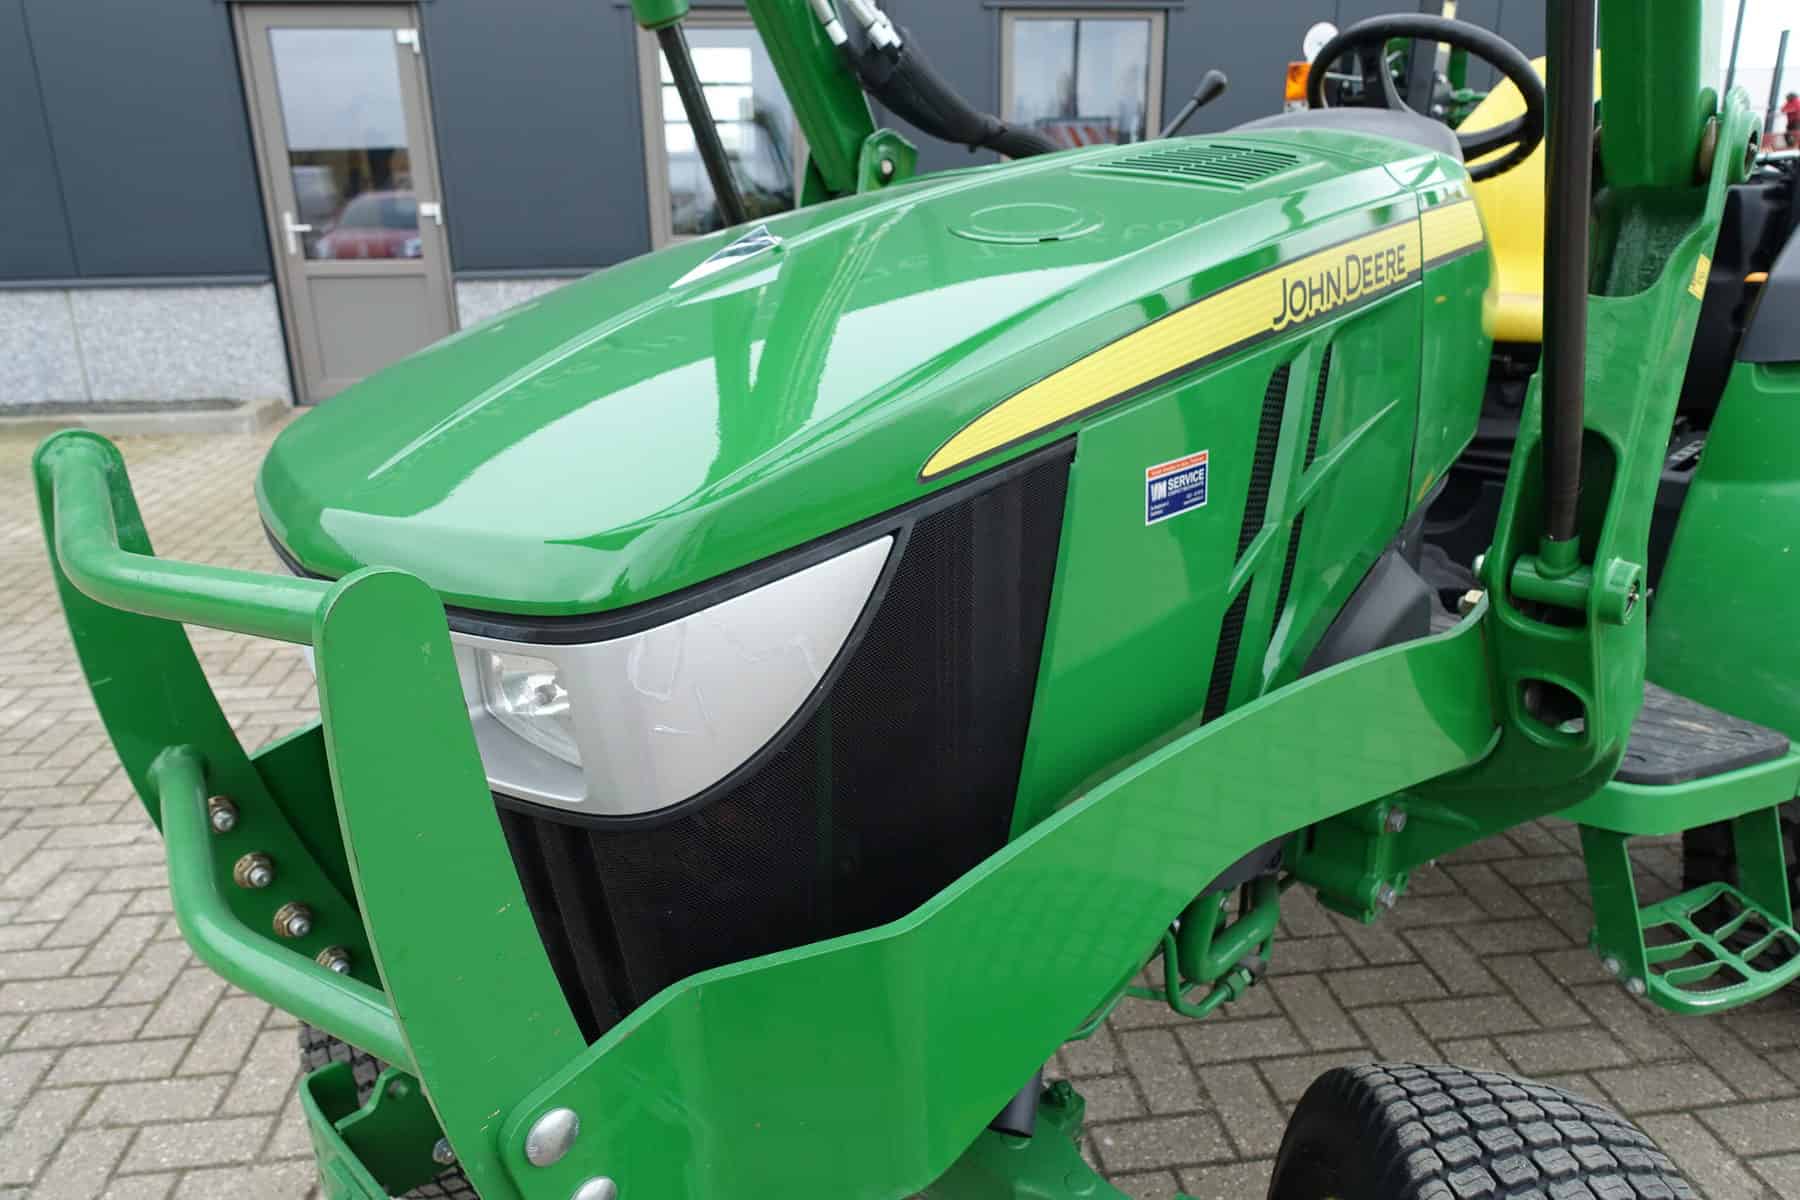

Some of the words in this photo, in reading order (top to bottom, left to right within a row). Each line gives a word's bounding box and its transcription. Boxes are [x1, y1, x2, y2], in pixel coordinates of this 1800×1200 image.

[1273, 266, 1341, 325] JOHN
[1345, 243, 1406, 296] DEERE
[1168, 467, 1204, 491] SERVICE
